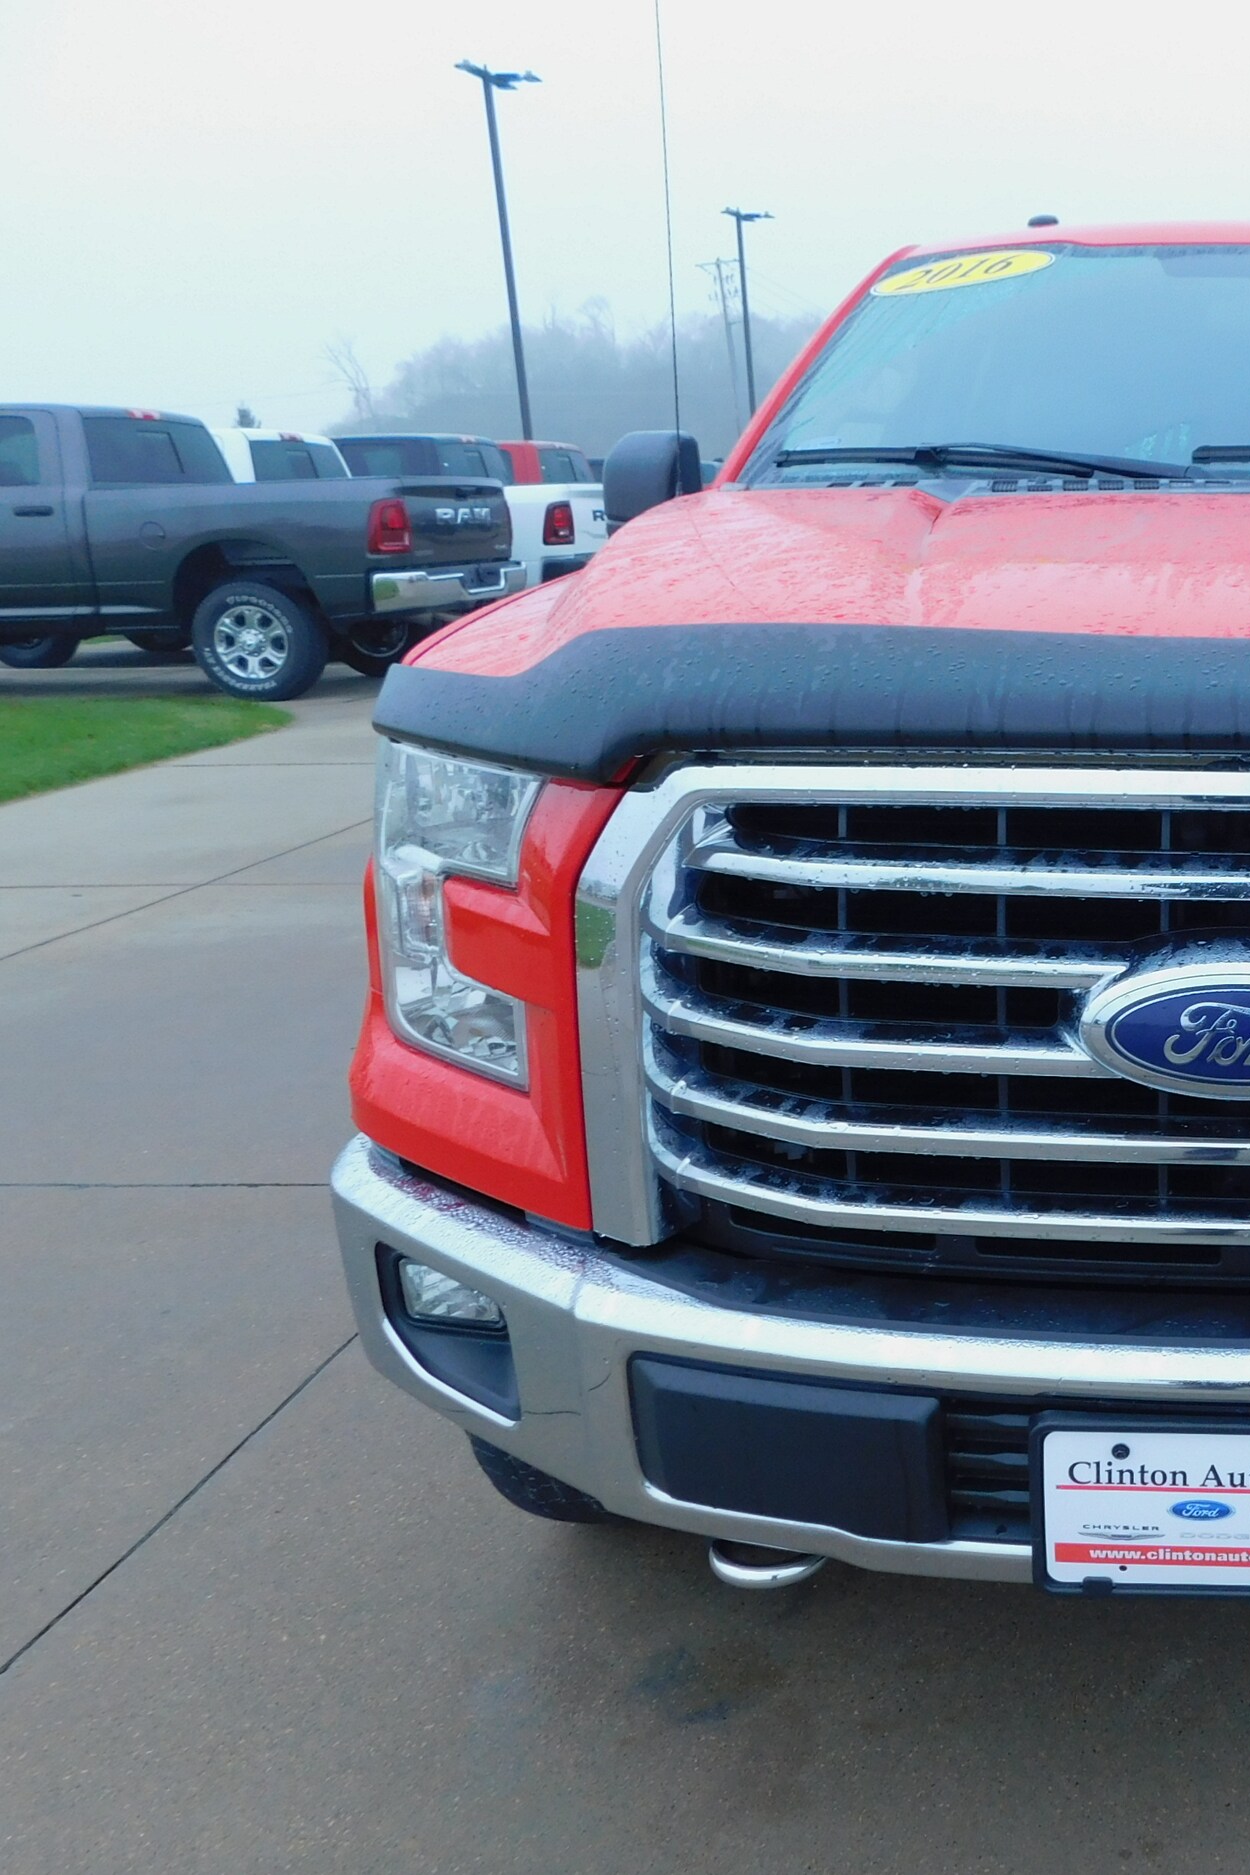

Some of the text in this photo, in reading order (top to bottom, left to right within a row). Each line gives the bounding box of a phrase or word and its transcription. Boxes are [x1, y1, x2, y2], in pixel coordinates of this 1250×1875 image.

[894, 254, 1024, 291] 2016
[435, 507, 492, 525] RAM
[1068, 1461, 1188, 1487] Clinton
[1182, 1503, 1220, 1519] Ford
[1082, 1523, 1160, 1532] CHRYSLER
